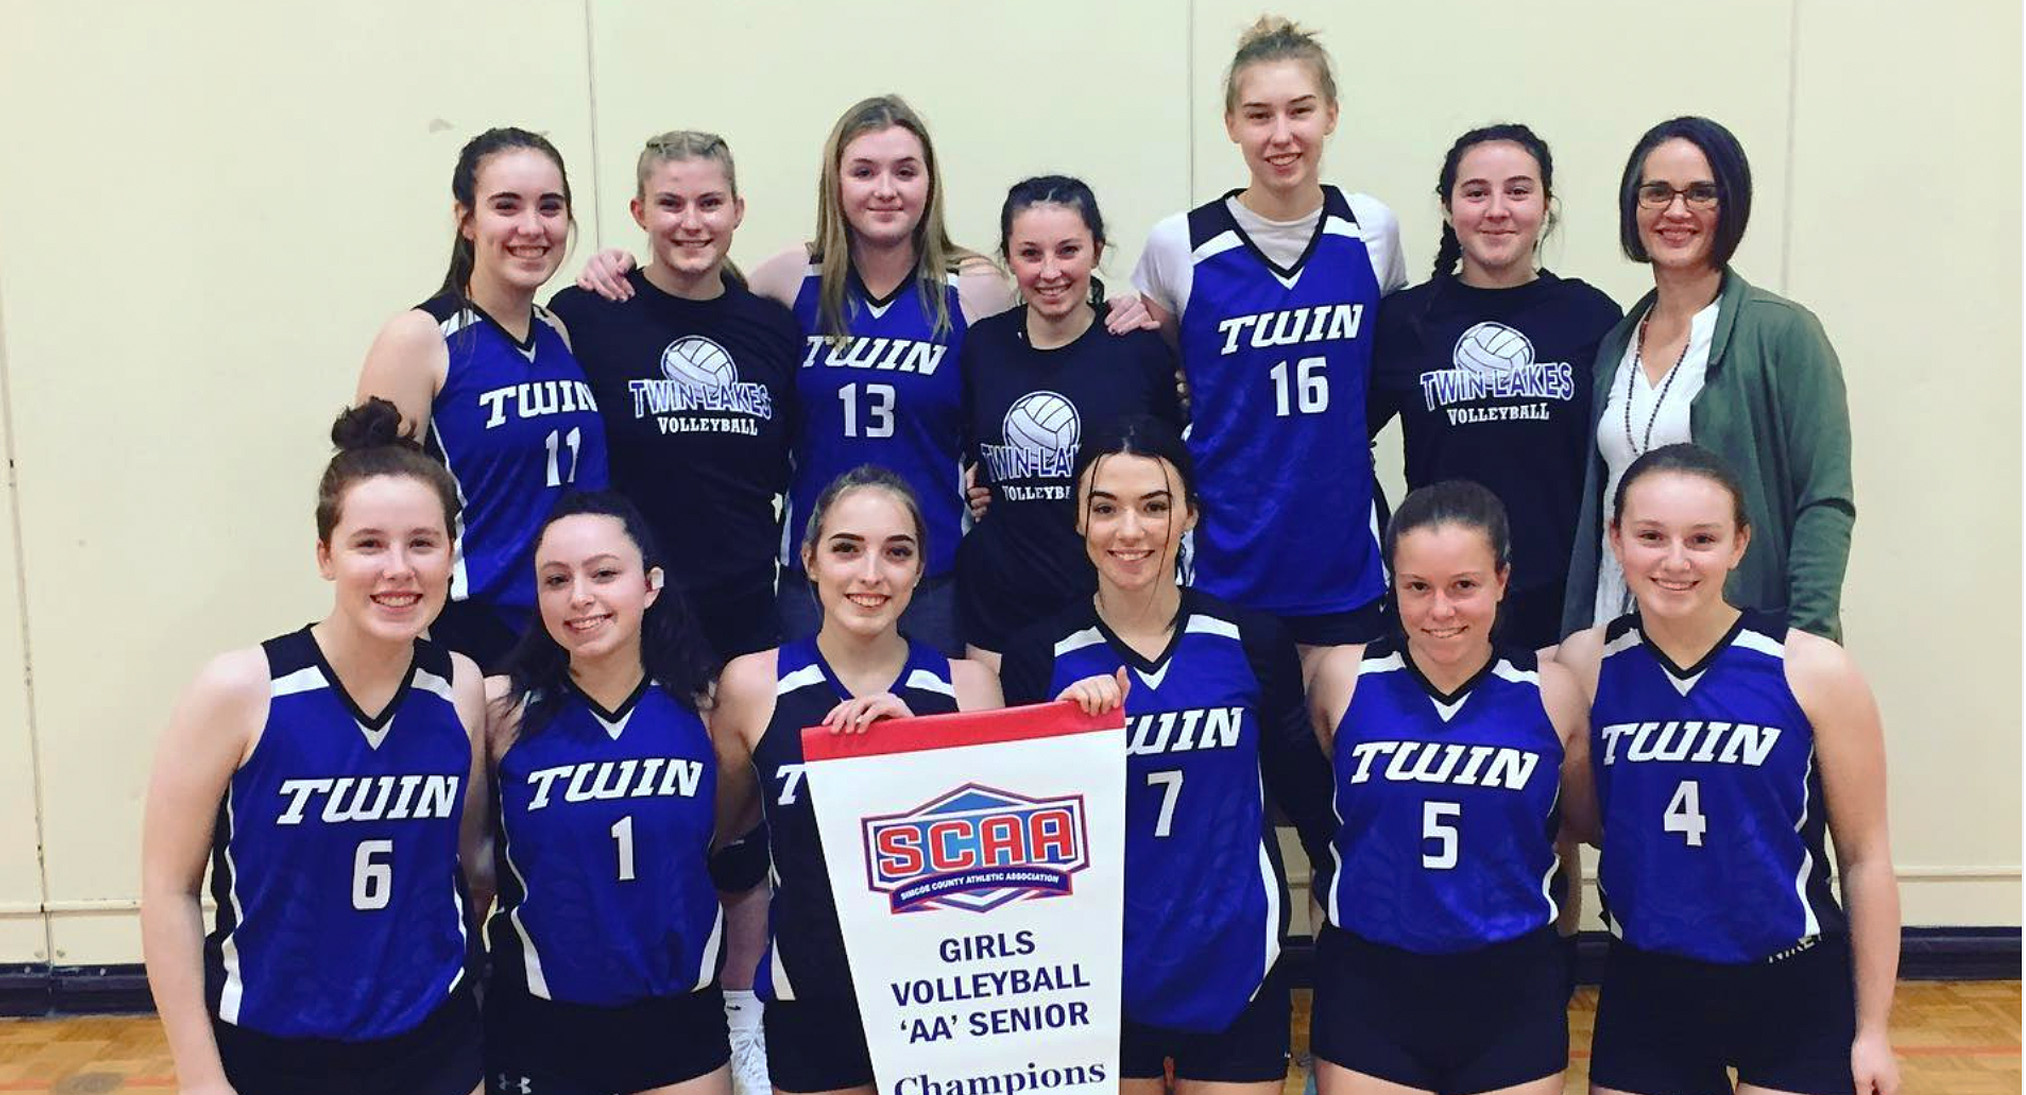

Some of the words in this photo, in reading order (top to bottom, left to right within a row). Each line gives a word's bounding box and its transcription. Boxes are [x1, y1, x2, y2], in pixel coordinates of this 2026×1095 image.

[1218, 303, 1365, 355] TWIN
[802, 335, 947, 375] TWIN
[479, 380, 598, 429] TWIN
[628, 379, 772, 420] TWIN-LAKES
[838, 382, 896, 438] 13
[1269, 355, 1329, 417] 16
[1420, 362, 1575, 411] TWIN-LAKES
[657, 416, 758, 436] VOLLEYBALL
[1446, 403, 1550, 426] VOLLEYBALL
[545, 426, 581, 487] 11
[980, 443, 1082, 482] TWIN-LA
[1002, 485, 1071, 501] VOLLEYB
[1125, 707, 1245, 756] WIN
[1602, 721, 1781, 767] TWIN
[526, 758, 702, 811] TWIN
[1350, 741, 1539, 792] TWIN
[276, 775, 459, 825] TWIN
[1147, 770, 1183, 837] 7
[1664, 780, 1706, 847] 4
[610, 815, 637, 881] 1
[876, 808, 1077, 878] SCAA
[1422, 801, 1461, 870] 5
[352, 840, 394, 911] 6
[932, 876, 964, 890] COUNTY
[966, 872, 1004, 884] ATHLETIC
[1005, 872, 1060, 883] ASSOCIATION
[939, 930, 1036, 963] GIRLS
[891, 963, 1091, 1007] VOLLEYBALL
[969, 1001, 1090, 1036] SENIOR
[894, 1062, 1106, 1095] Champions
